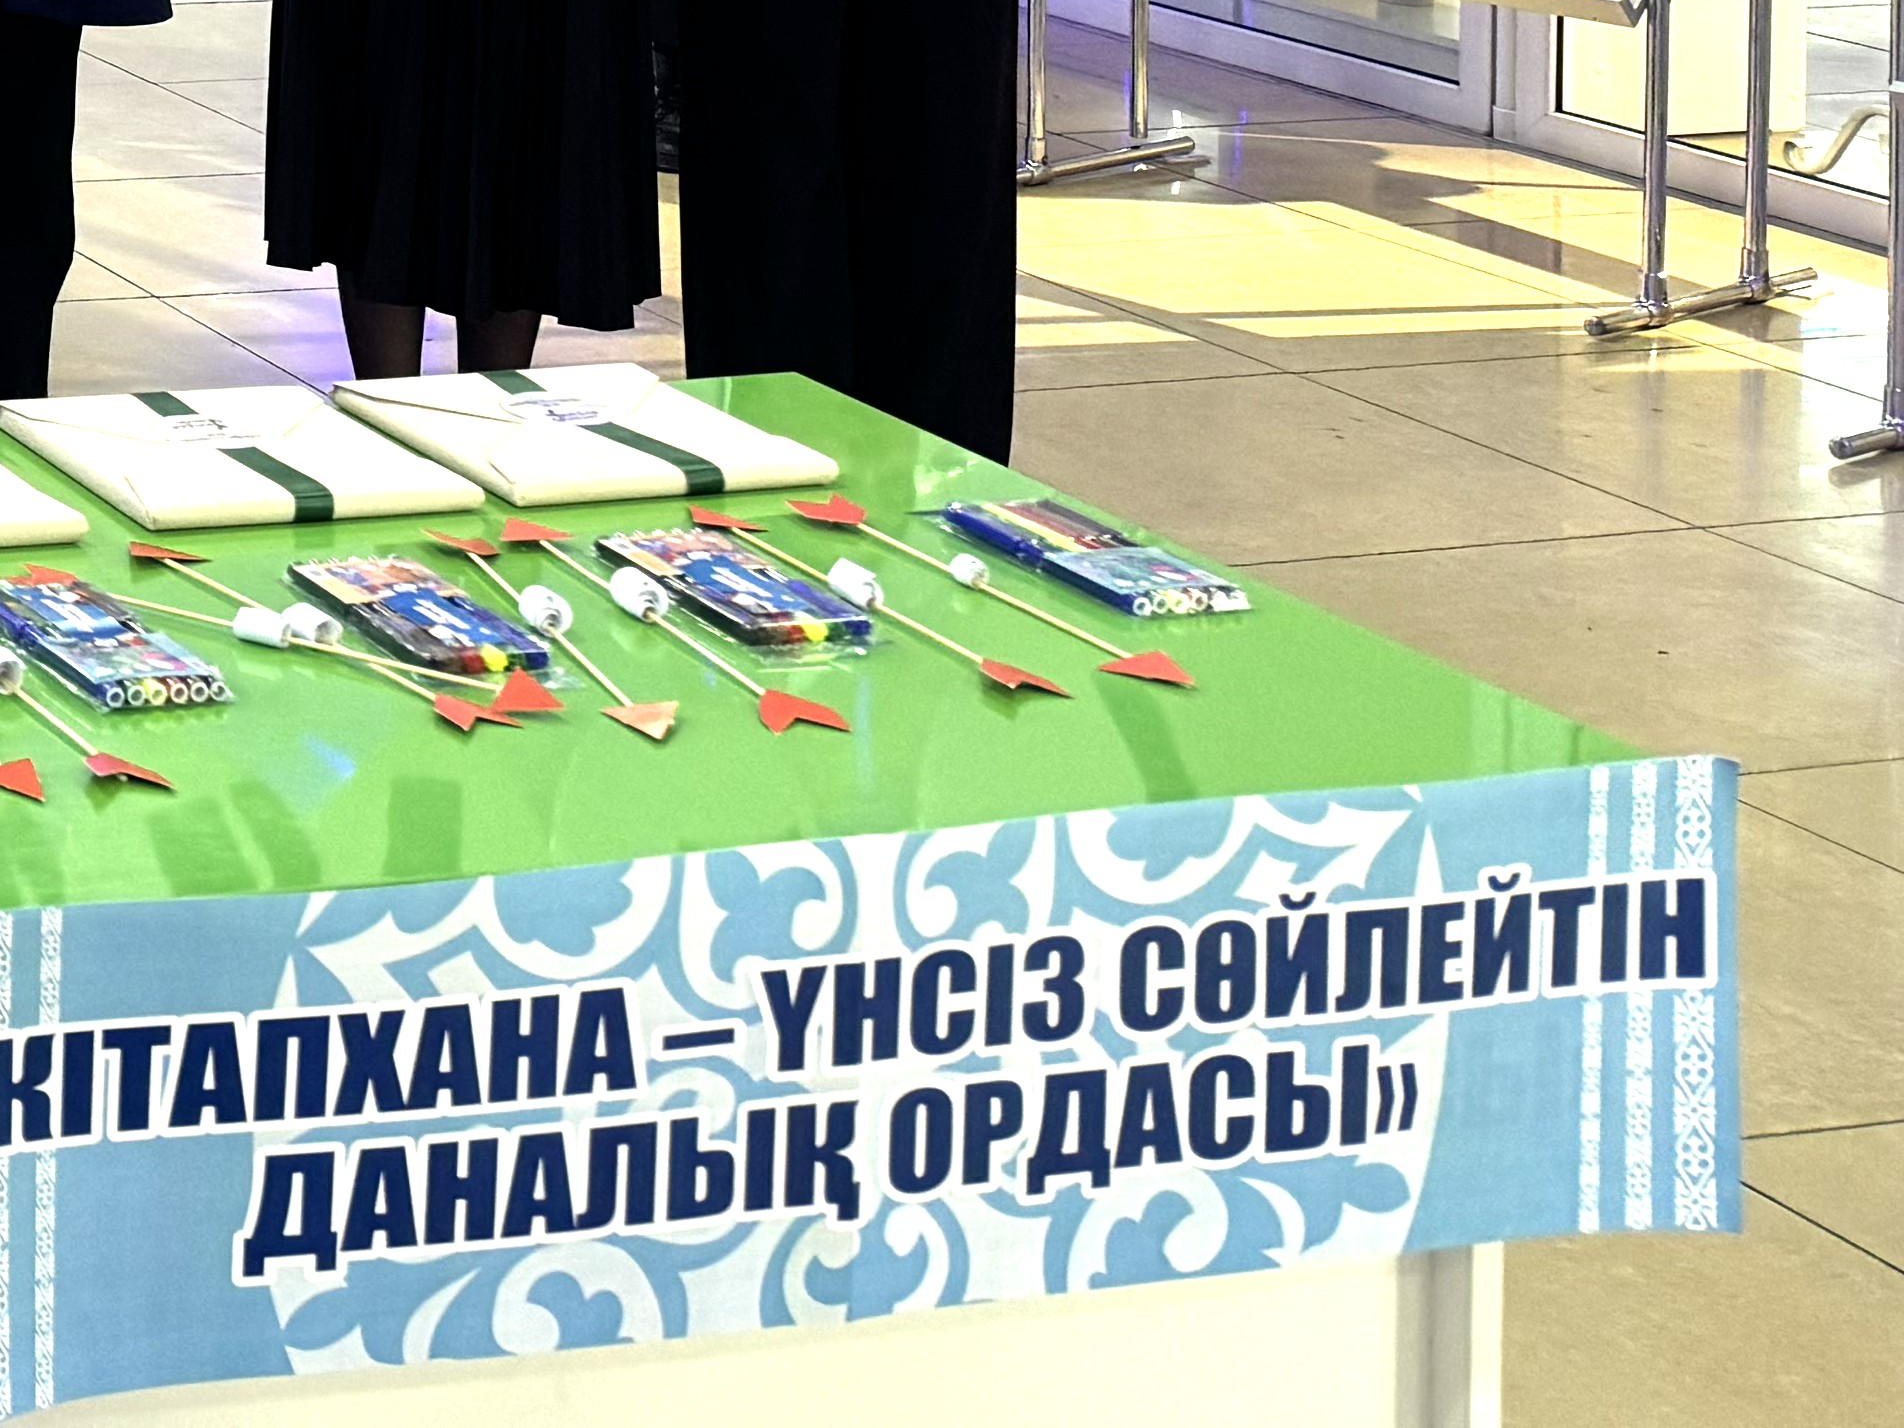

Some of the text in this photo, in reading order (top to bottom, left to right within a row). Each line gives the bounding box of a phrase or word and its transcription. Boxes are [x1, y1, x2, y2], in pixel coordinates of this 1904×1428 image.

[760, 935, 1087, 1072] ҮНСІЗ
[1119, 868, 1707, 1034] СӨЙЛЕЙТІН
[242, 1041, 1421, 1278] ДАНАЛЫҚ ОРДАСЫ»
